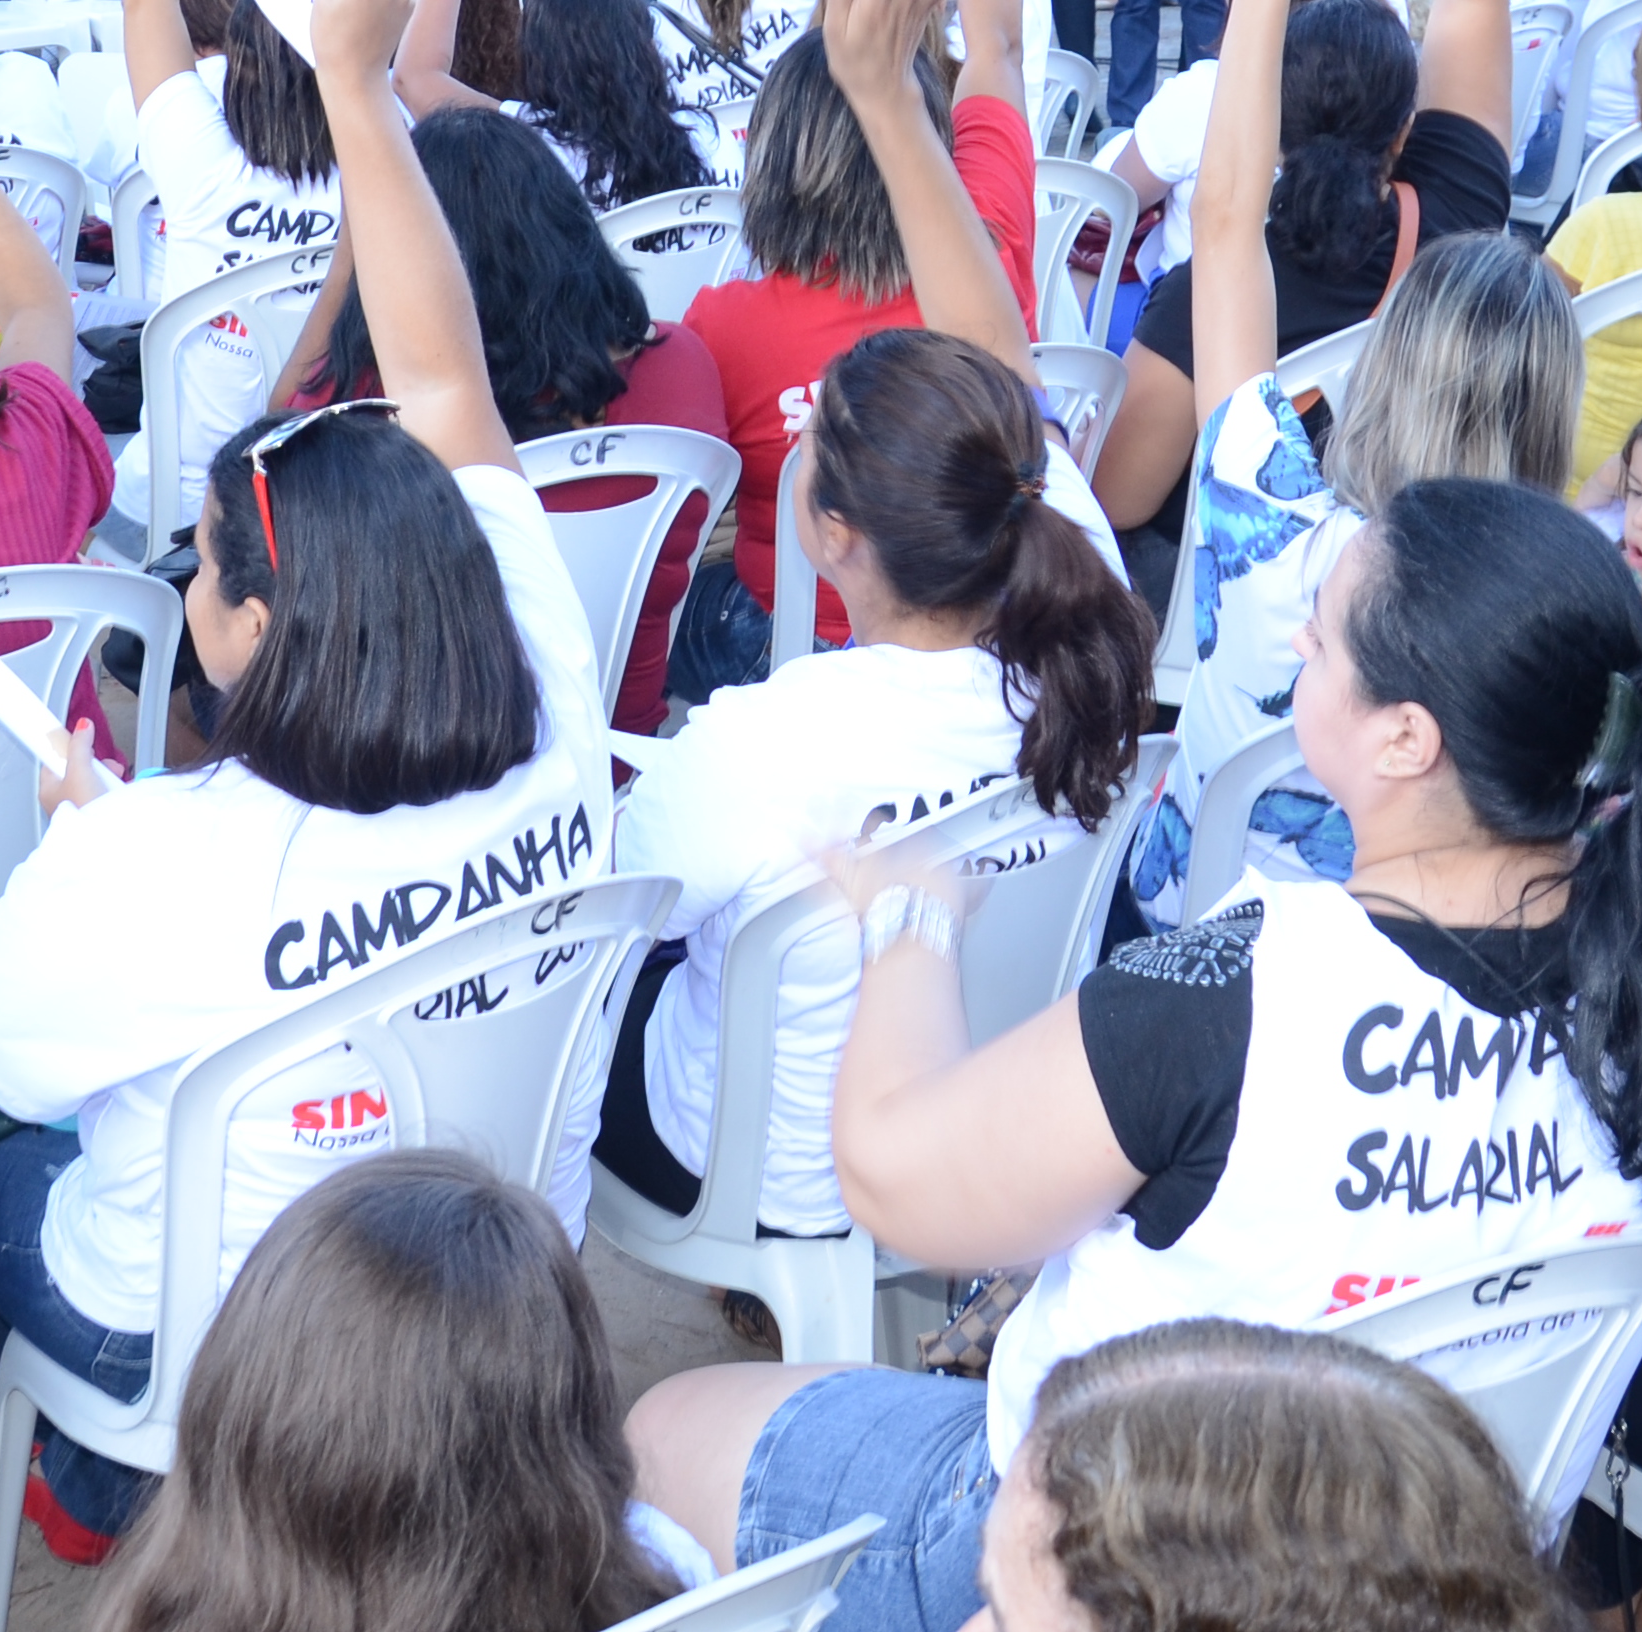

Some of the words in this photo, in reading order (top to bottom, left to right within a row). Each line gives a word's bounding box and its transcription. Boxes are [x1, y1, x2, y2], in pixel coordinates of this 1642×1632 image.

[680, 193, 712, 215] CF
[291, 246, 335, 274] CF
[205, 331, 254, 359] Nossa
[569, 432, 626, 467] CF
[531, 889, 584, 935] CF
[1472, 1263, 1546, 1307] CF
